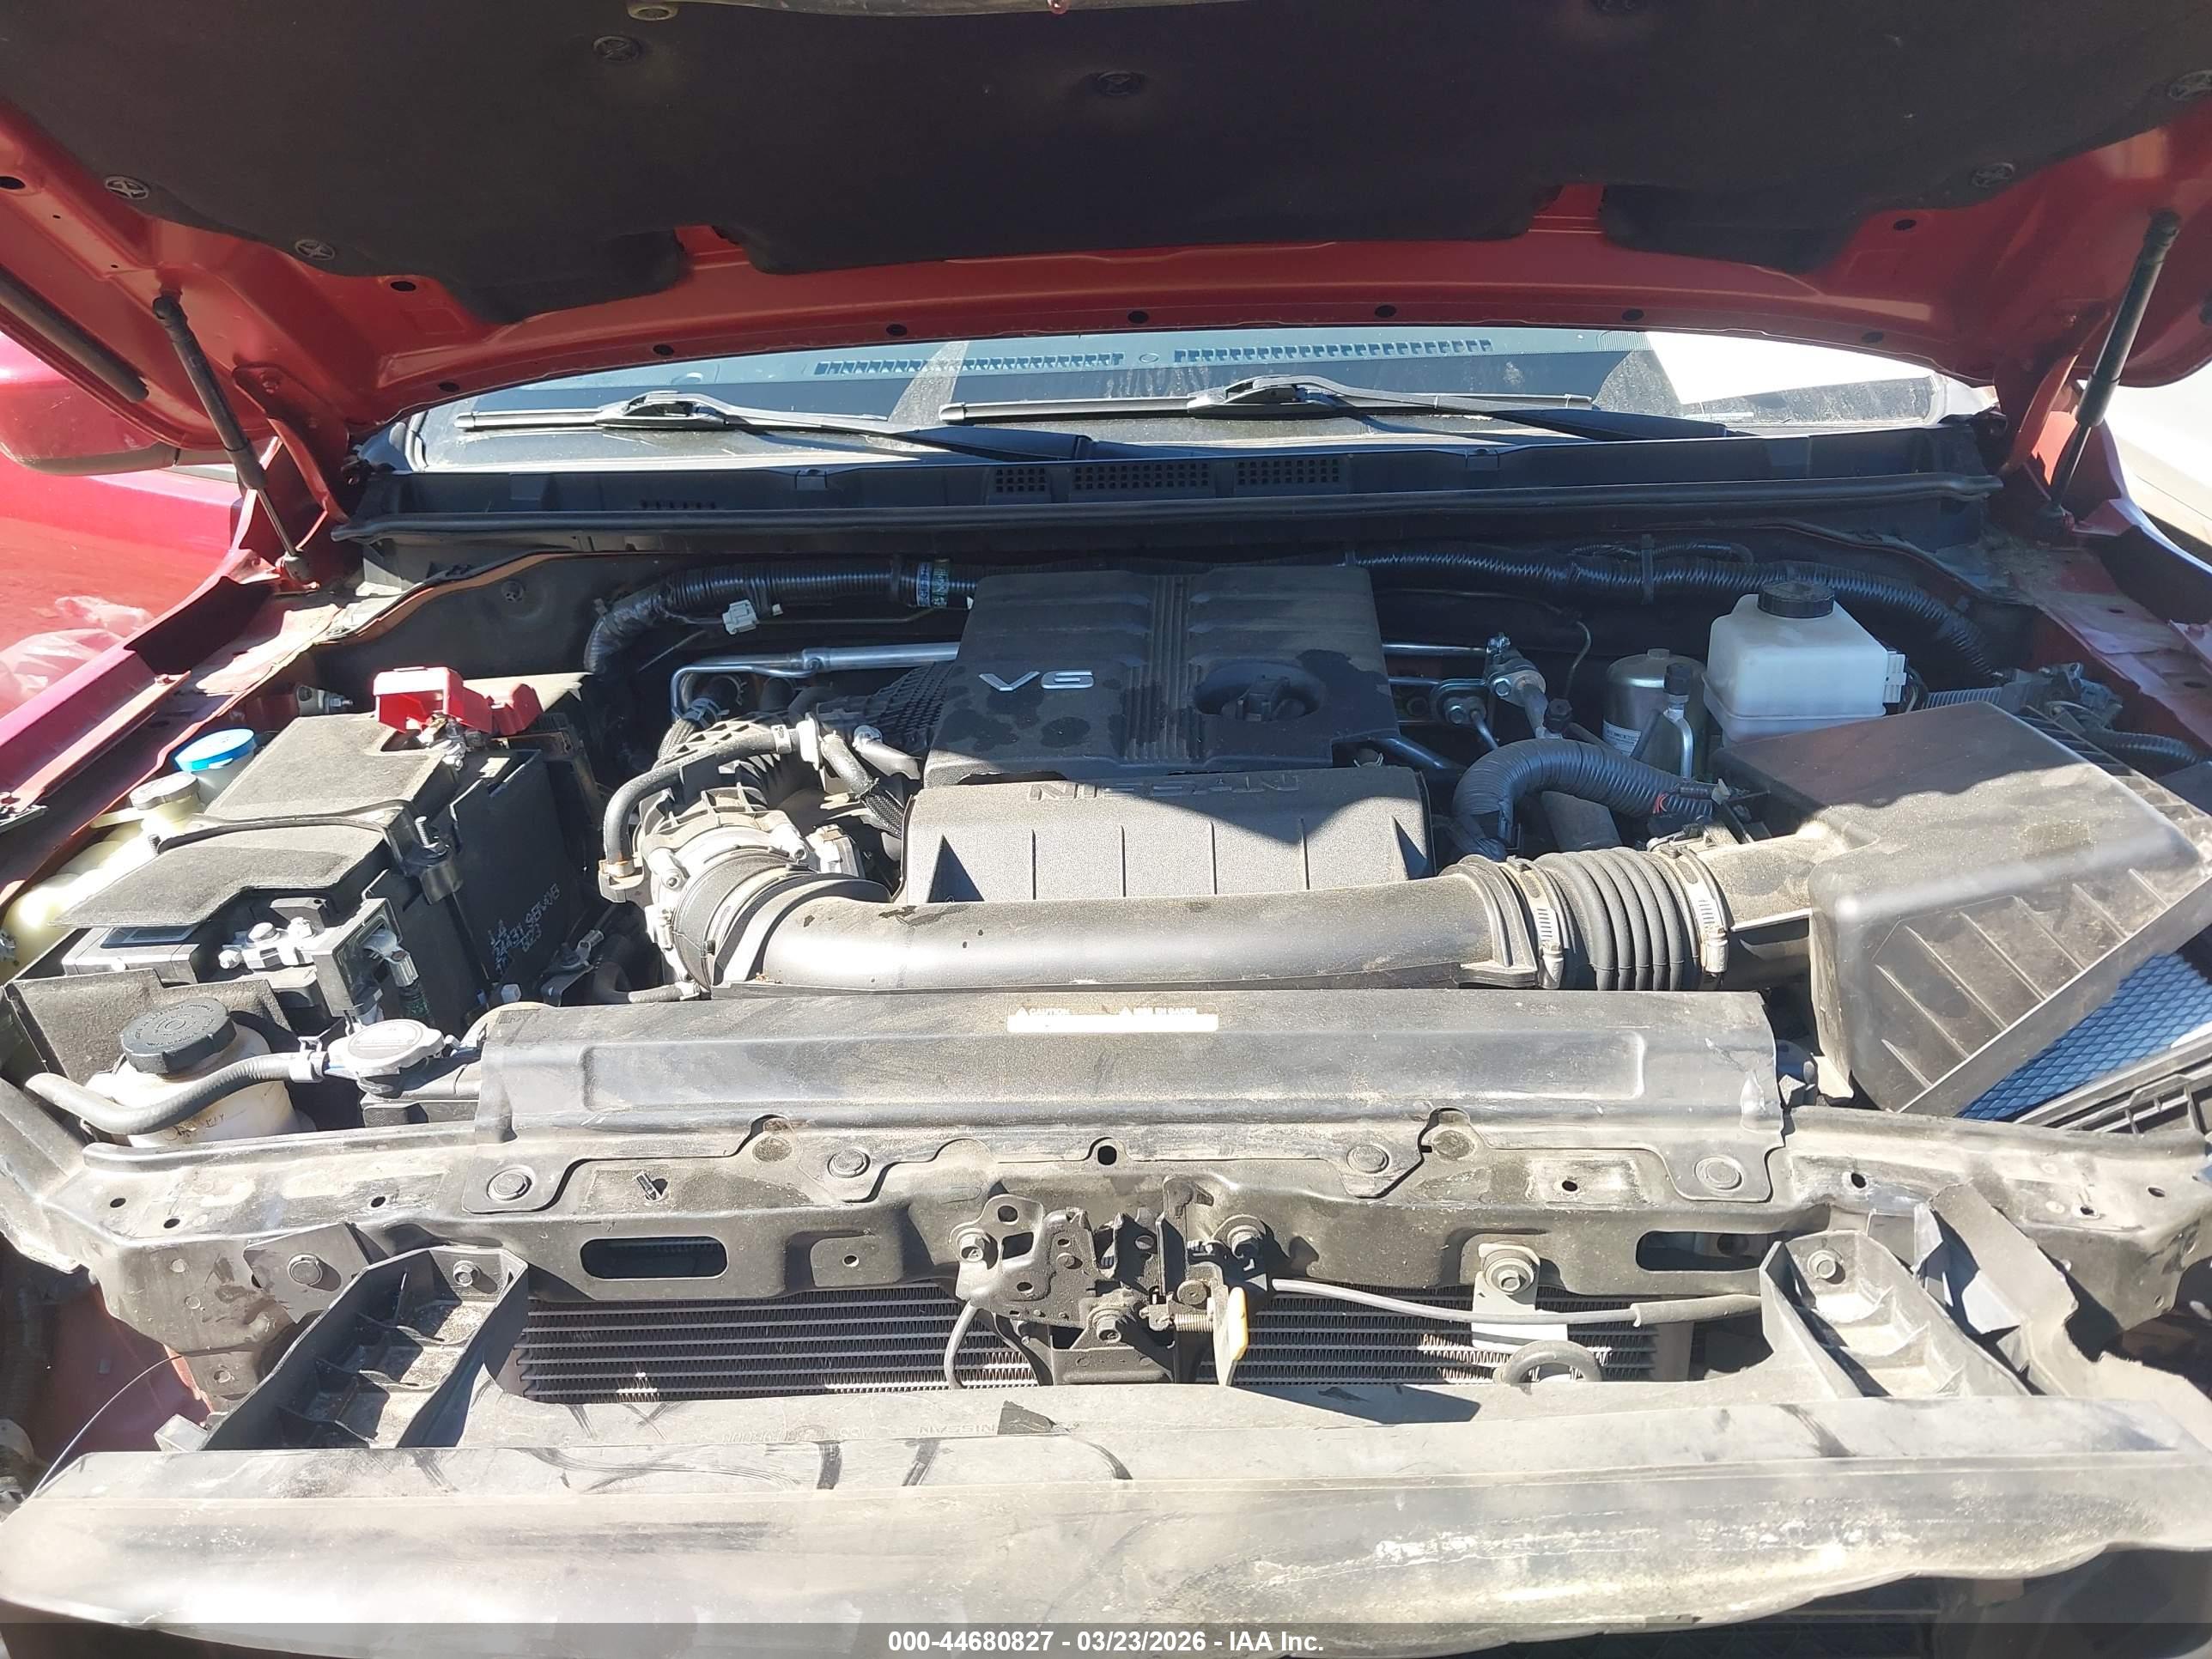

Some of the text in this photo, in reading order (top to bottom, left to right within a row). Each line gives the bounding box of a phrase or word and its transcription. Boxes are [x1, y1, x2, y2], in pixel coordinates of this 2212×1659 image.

[979, 670, 1094, 691] V6
[1027, 773, 1300, 801] NISSAN
[918, 1423, 996, 1437] NISSAN
